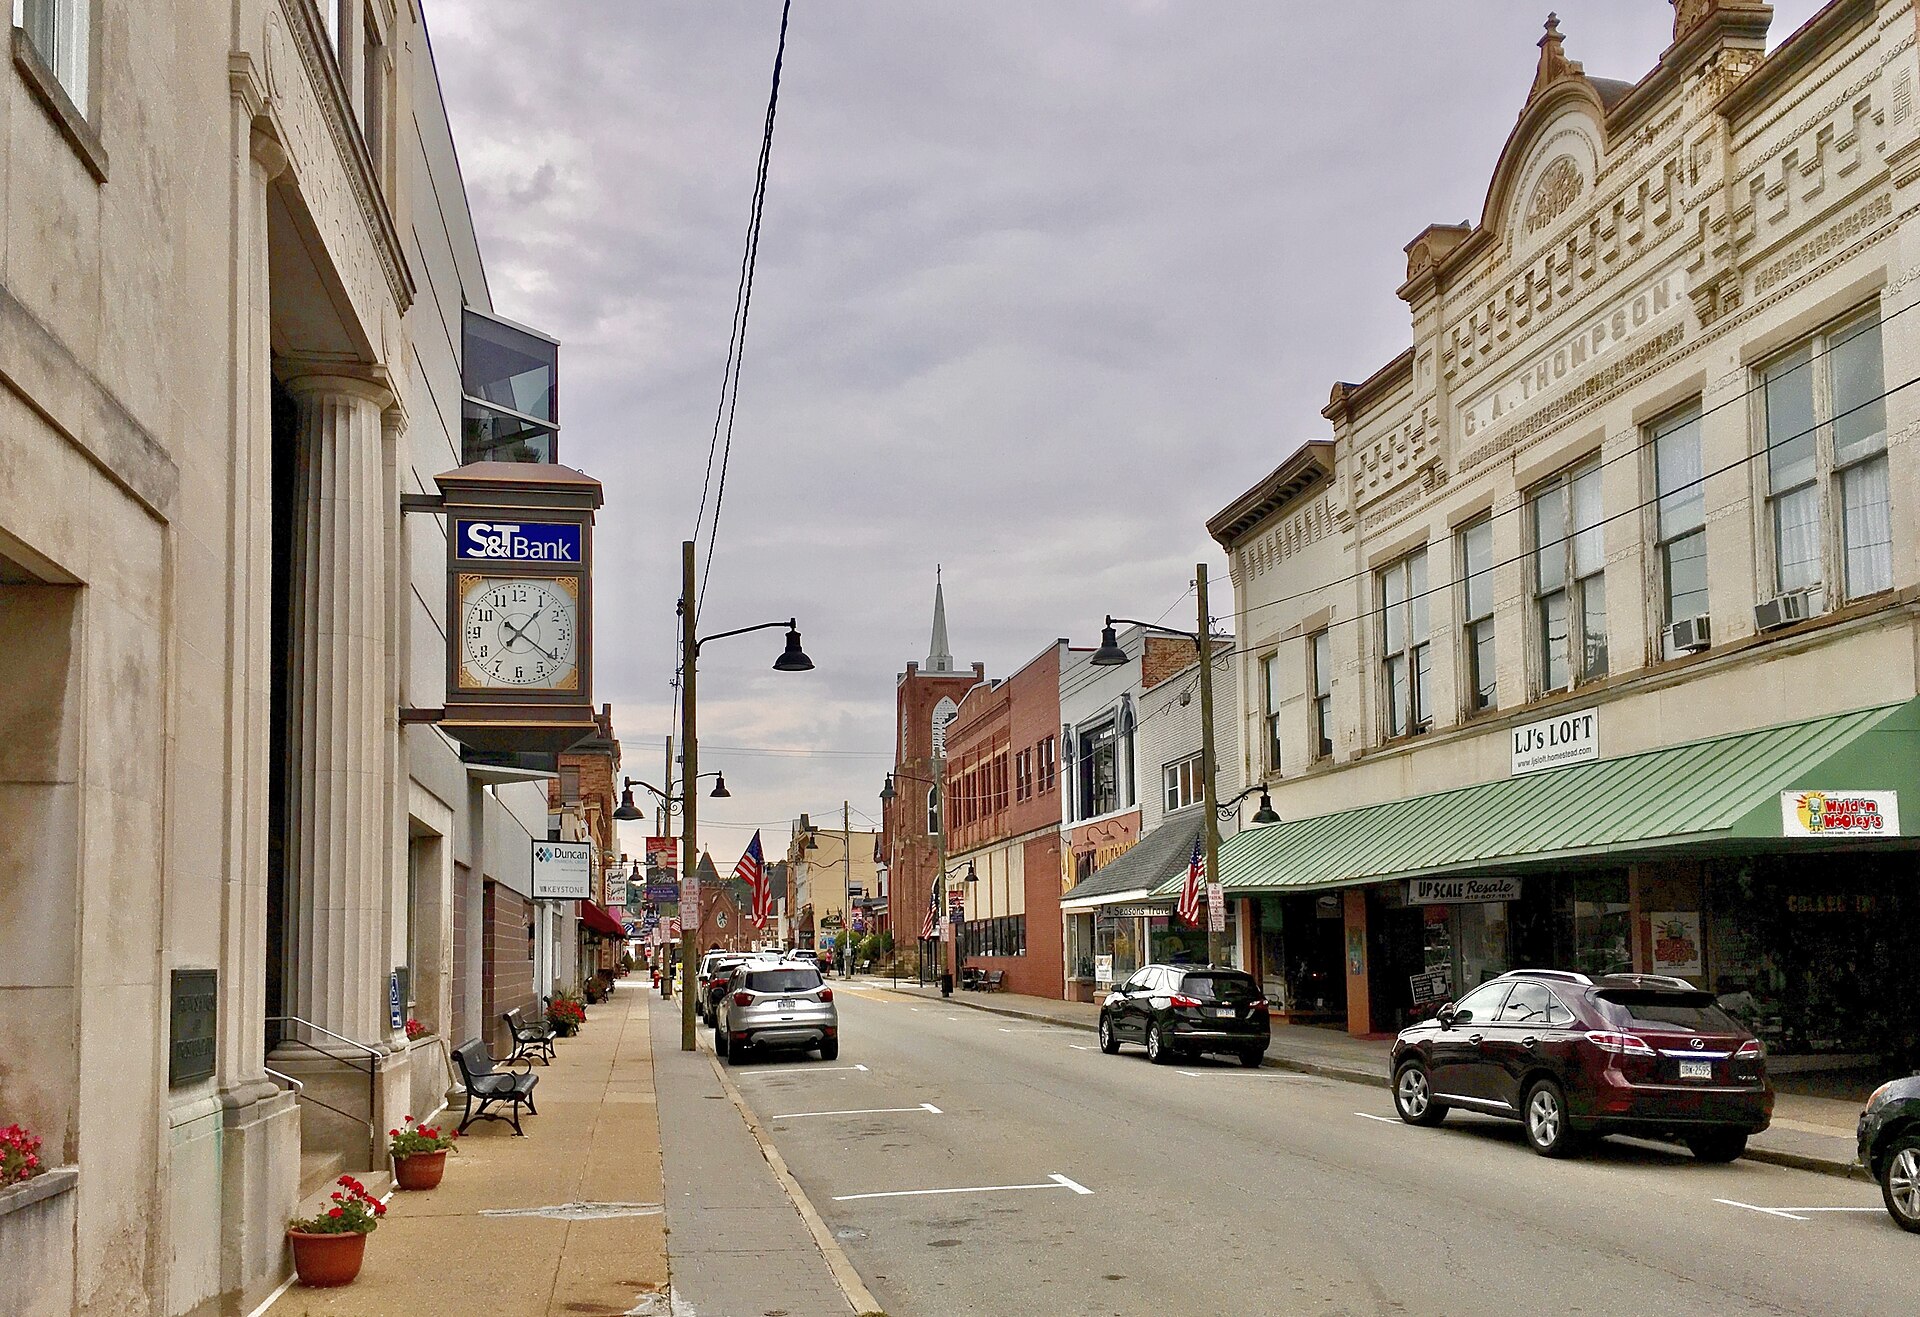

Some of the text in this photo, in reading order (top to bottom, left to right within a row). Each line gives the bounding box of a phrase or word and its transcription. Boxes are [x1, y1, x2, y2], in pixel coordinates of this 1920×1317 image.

[467, 523, 572, 560] S&T Bank
[494, 595, 507, 607] 11
[512, 590, 526, 602] 12
[478, 609, 493, 621] 10
[1515, 715, 1593, 754] LJ's LOFT
[554, 847, 588, 860] Duncan
[547, 886, 584, 894] KEYSTONE
[1466, 880, 1514, 894] Resale
[1106, 906, 1171, 916] 4 Seasons Travel
